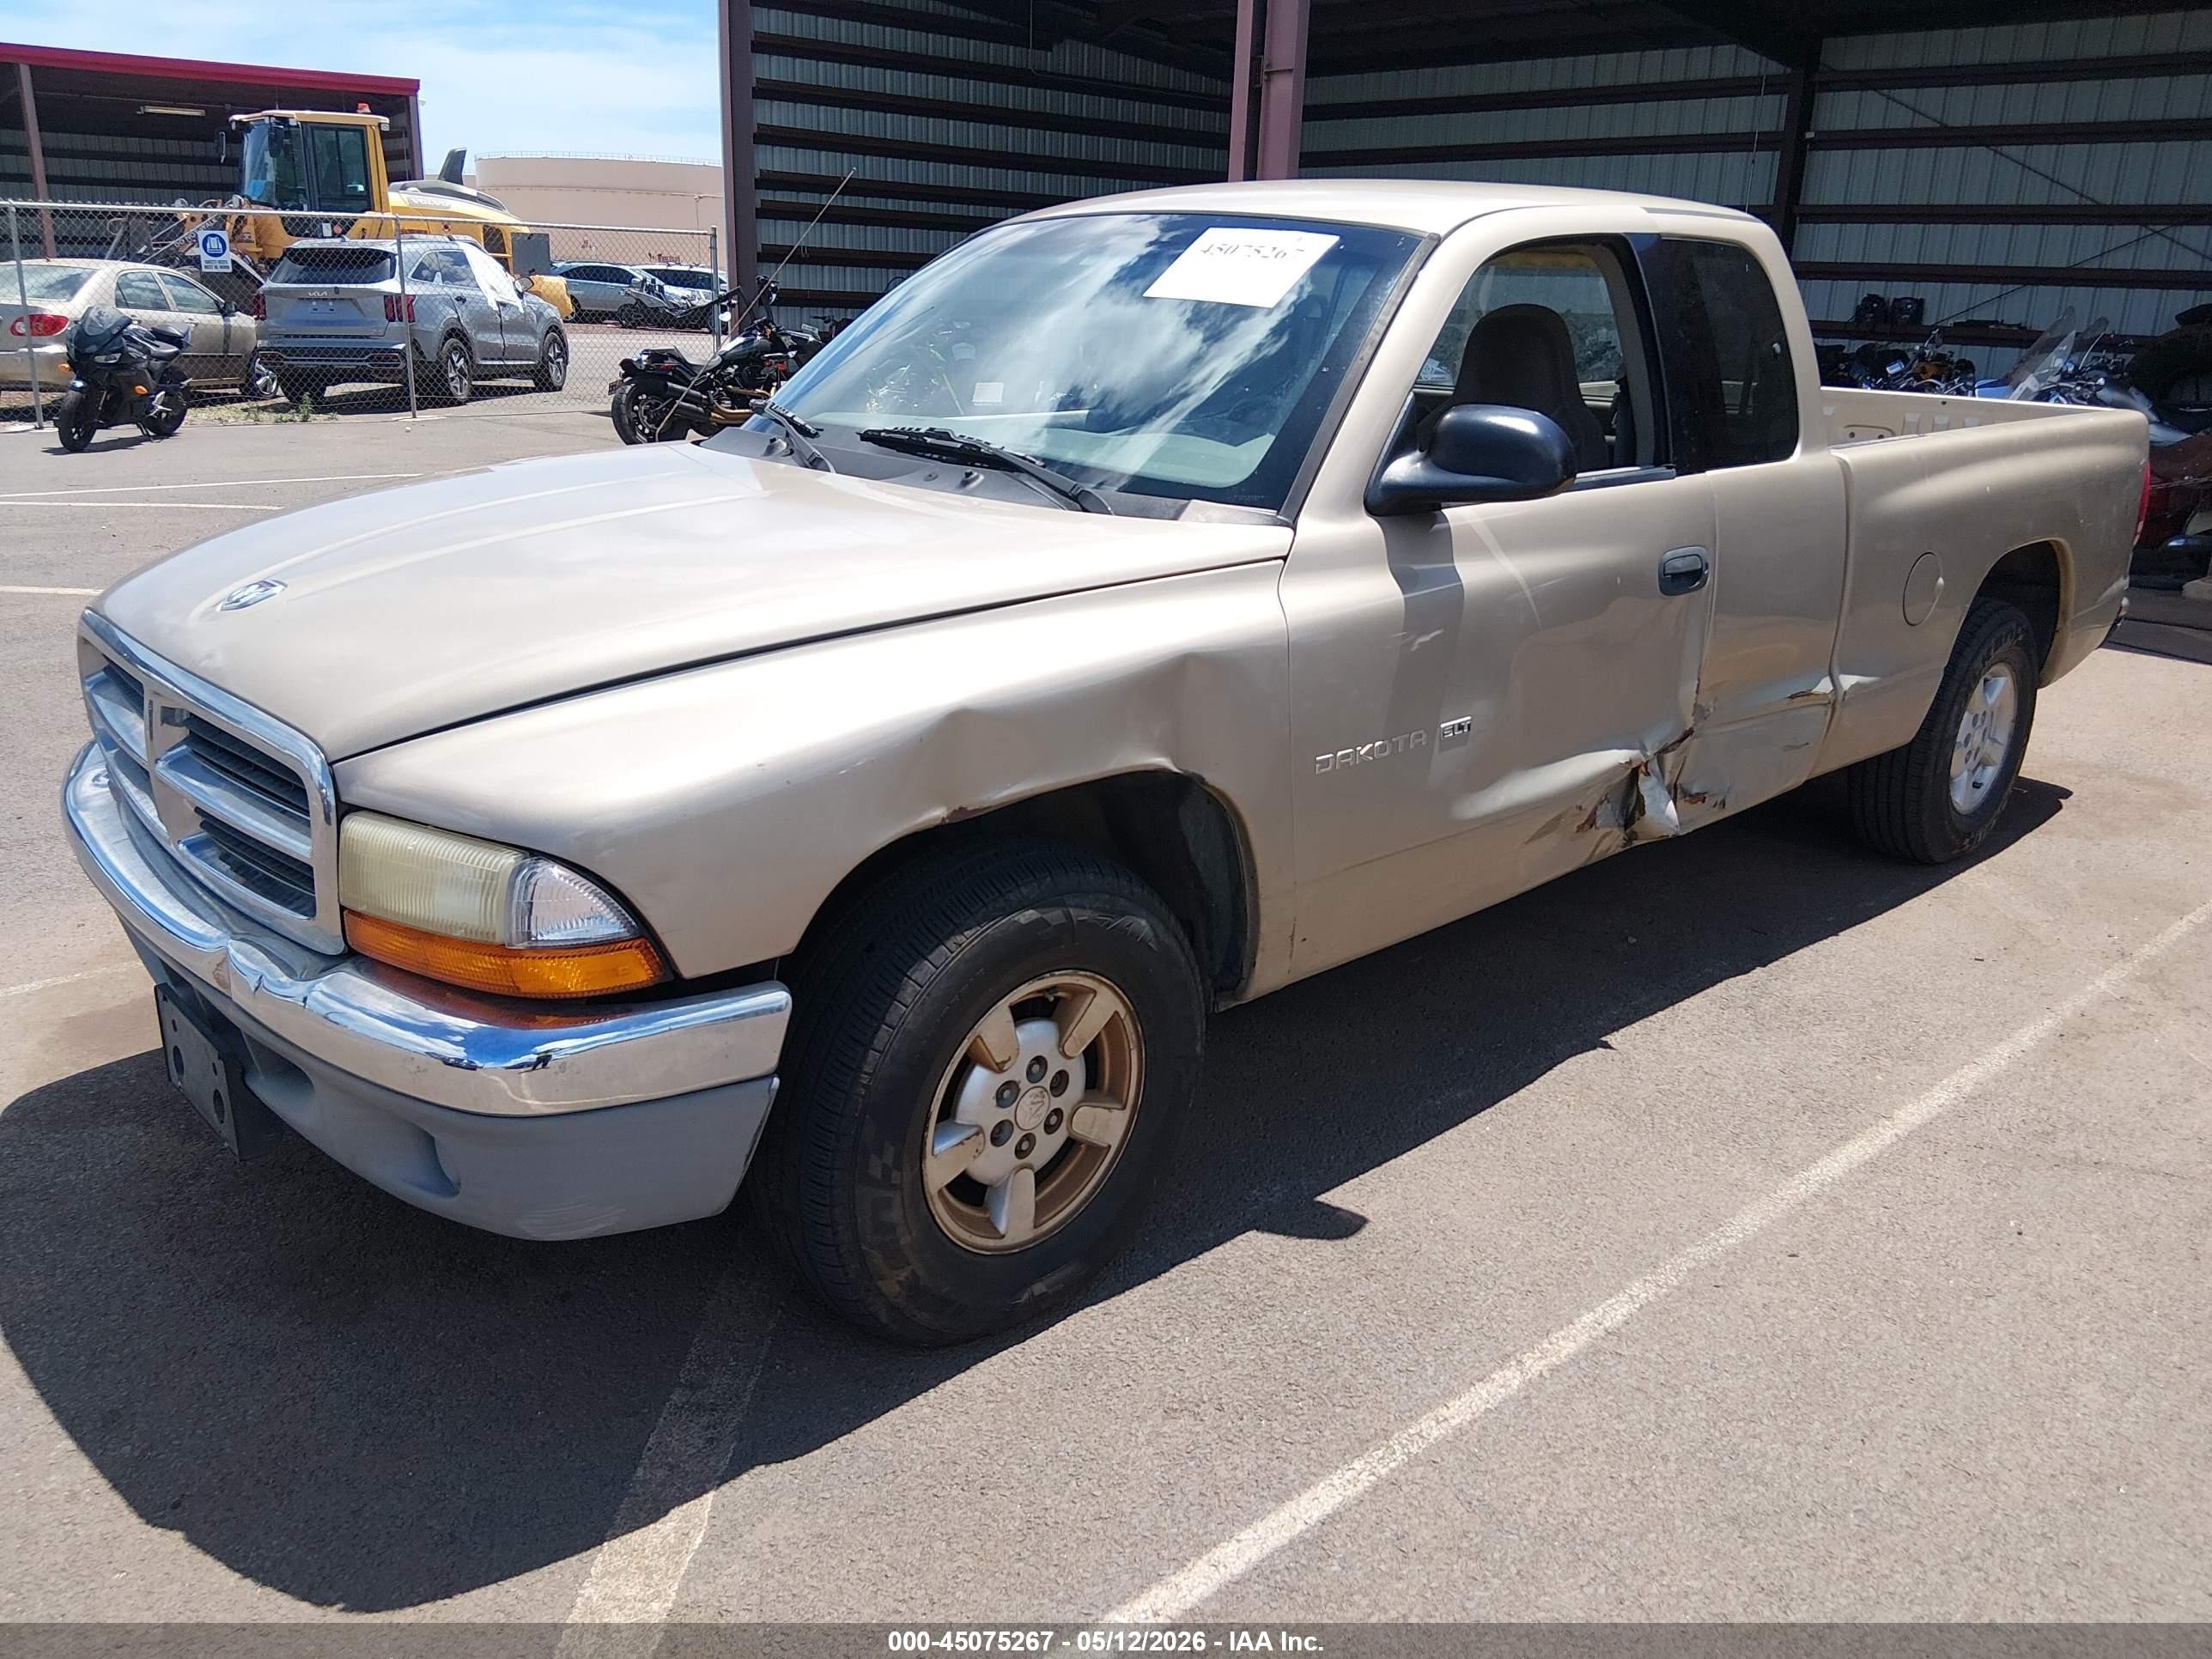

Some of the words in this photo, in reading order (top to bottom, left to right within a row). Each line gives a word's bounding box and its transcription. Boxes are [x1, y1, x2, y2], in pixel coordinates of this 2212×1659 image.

[410, 197, 449, 207] VOLVO
[1315, 730, 1429, 775] DAKOTA
[1441, 720, 1472, 739] SLT
